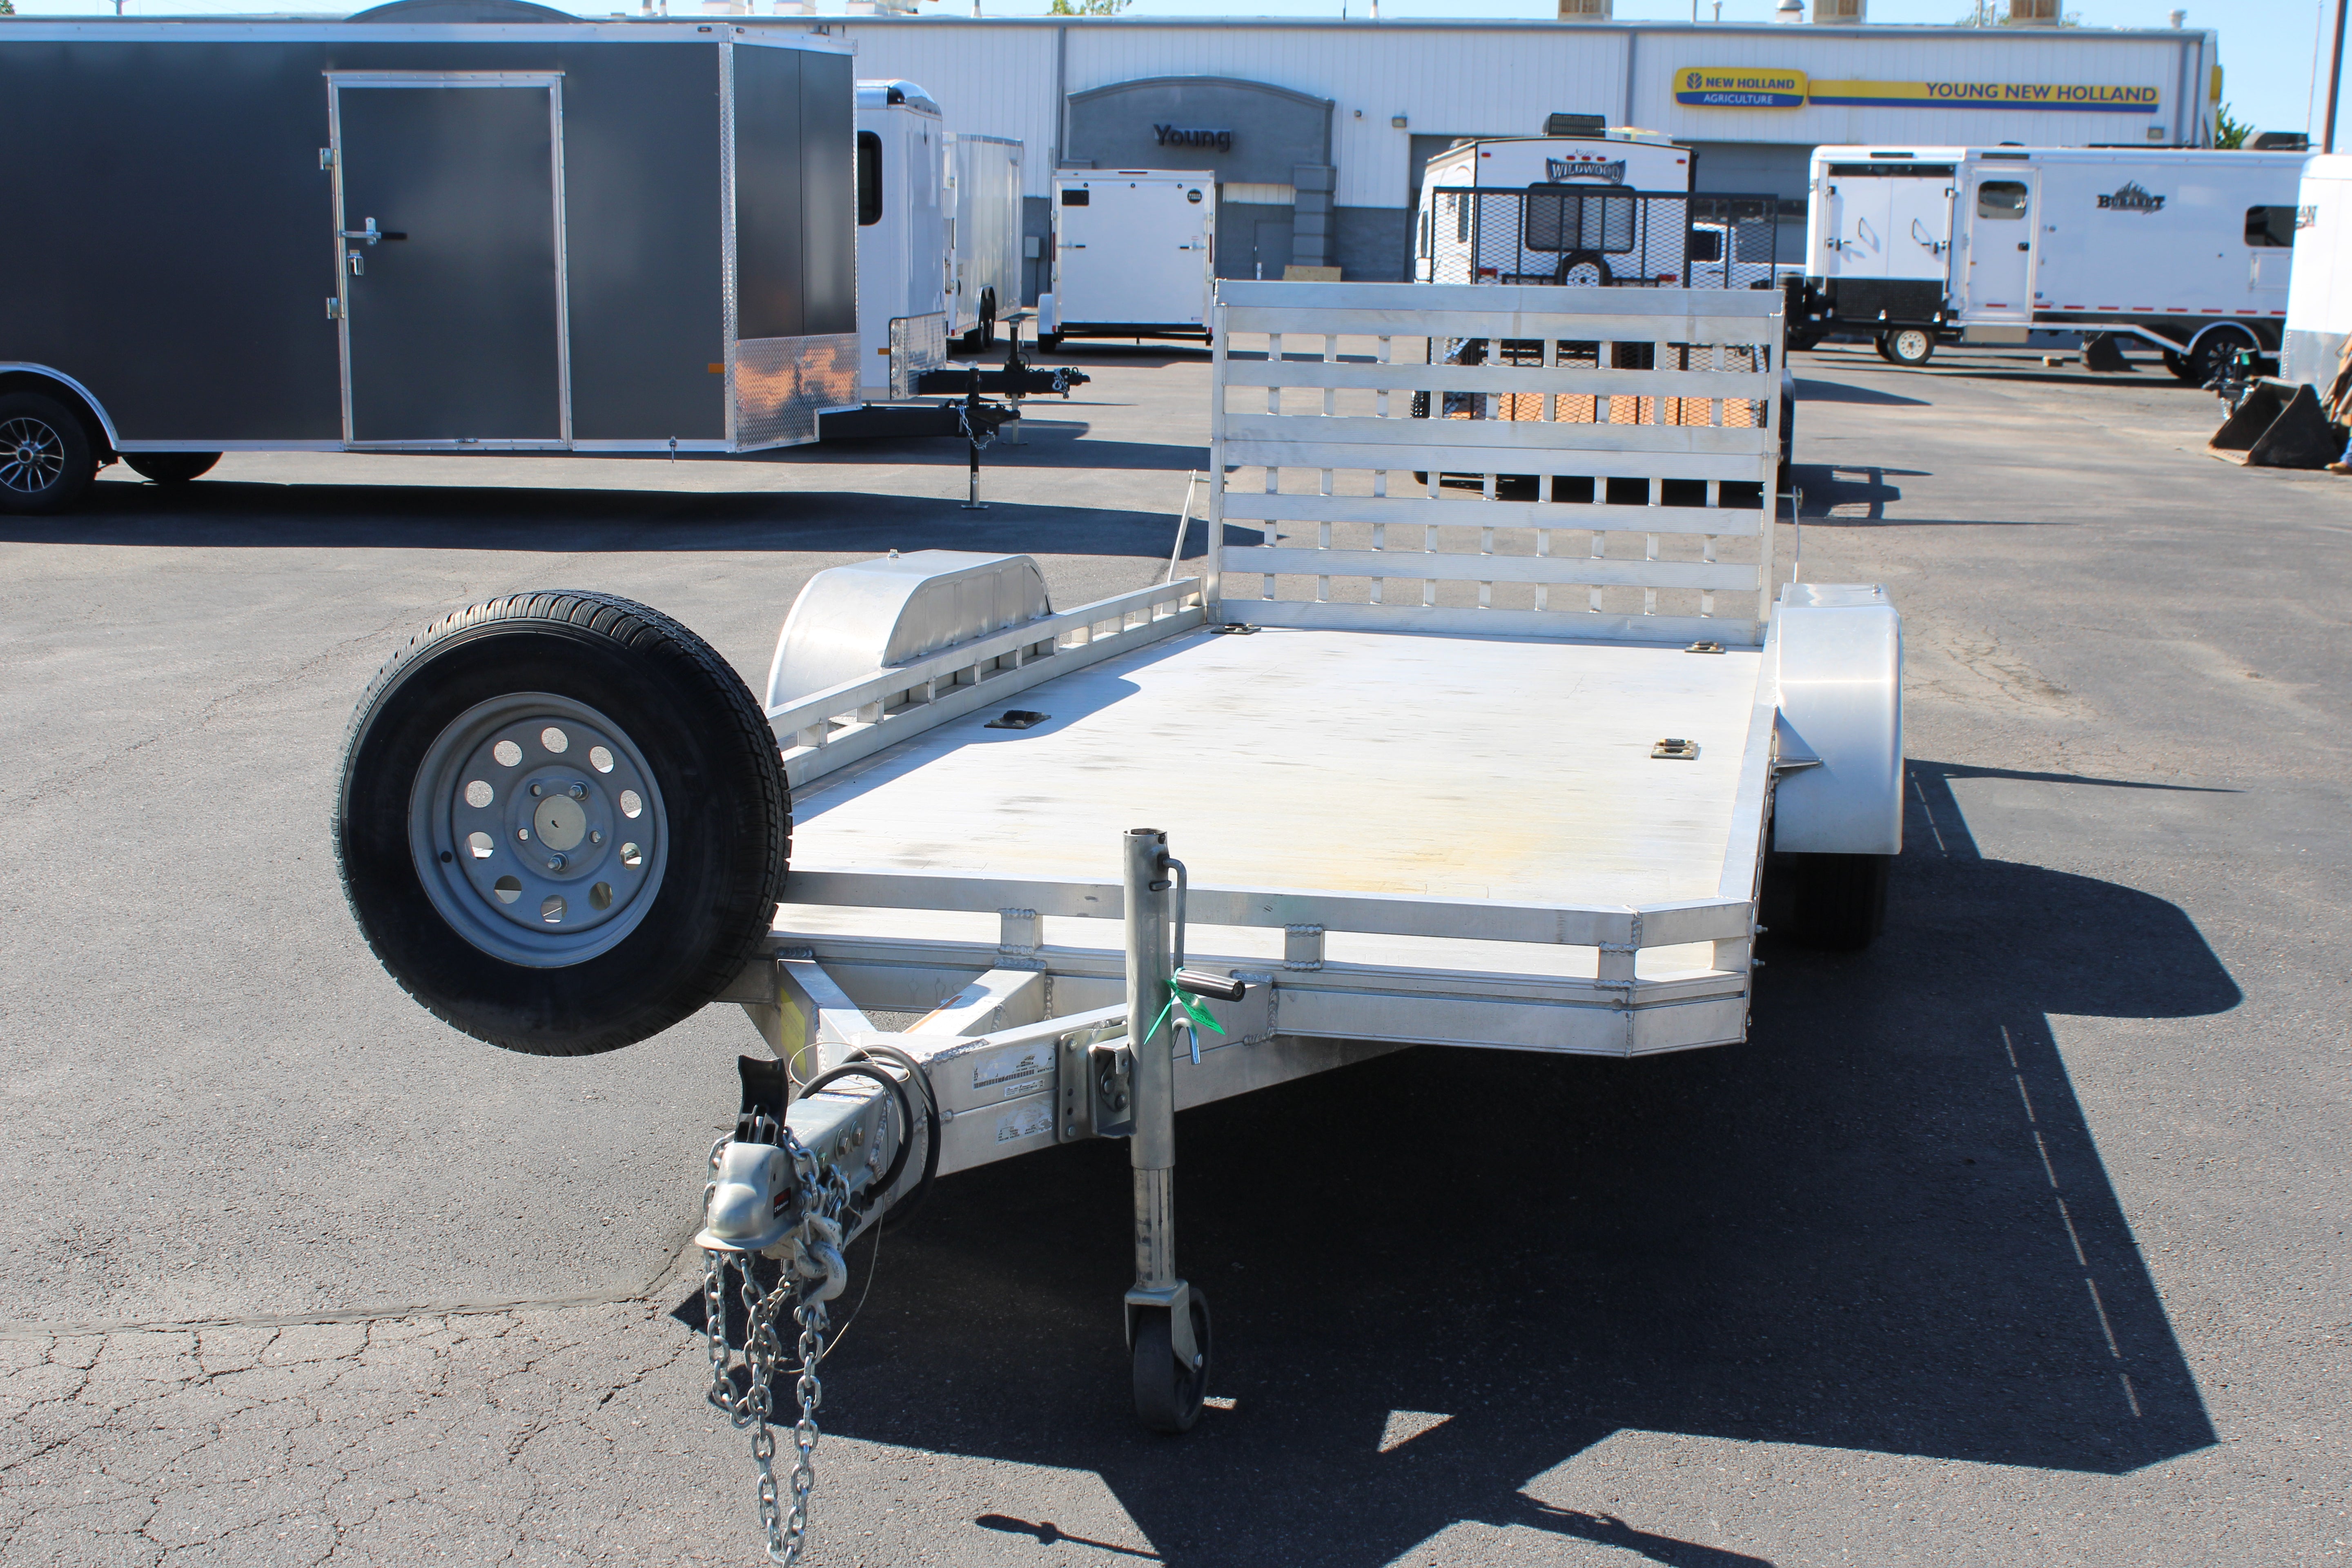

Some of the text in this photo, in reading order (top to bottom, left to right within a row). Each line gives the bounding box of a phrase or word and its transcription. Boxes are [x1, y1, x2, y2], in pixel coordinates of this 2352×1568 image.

[1706, 77, 1795, 89] NEW HOLLAND
[1704, 94, 1773, 104] AGRICULTURE
[1926, 83, 2157, 101] YOUNG NEW HOLLAND
[1154, 123, 1232, 152] Young
[1552, 163, 1620, 180] WILDWOOD
